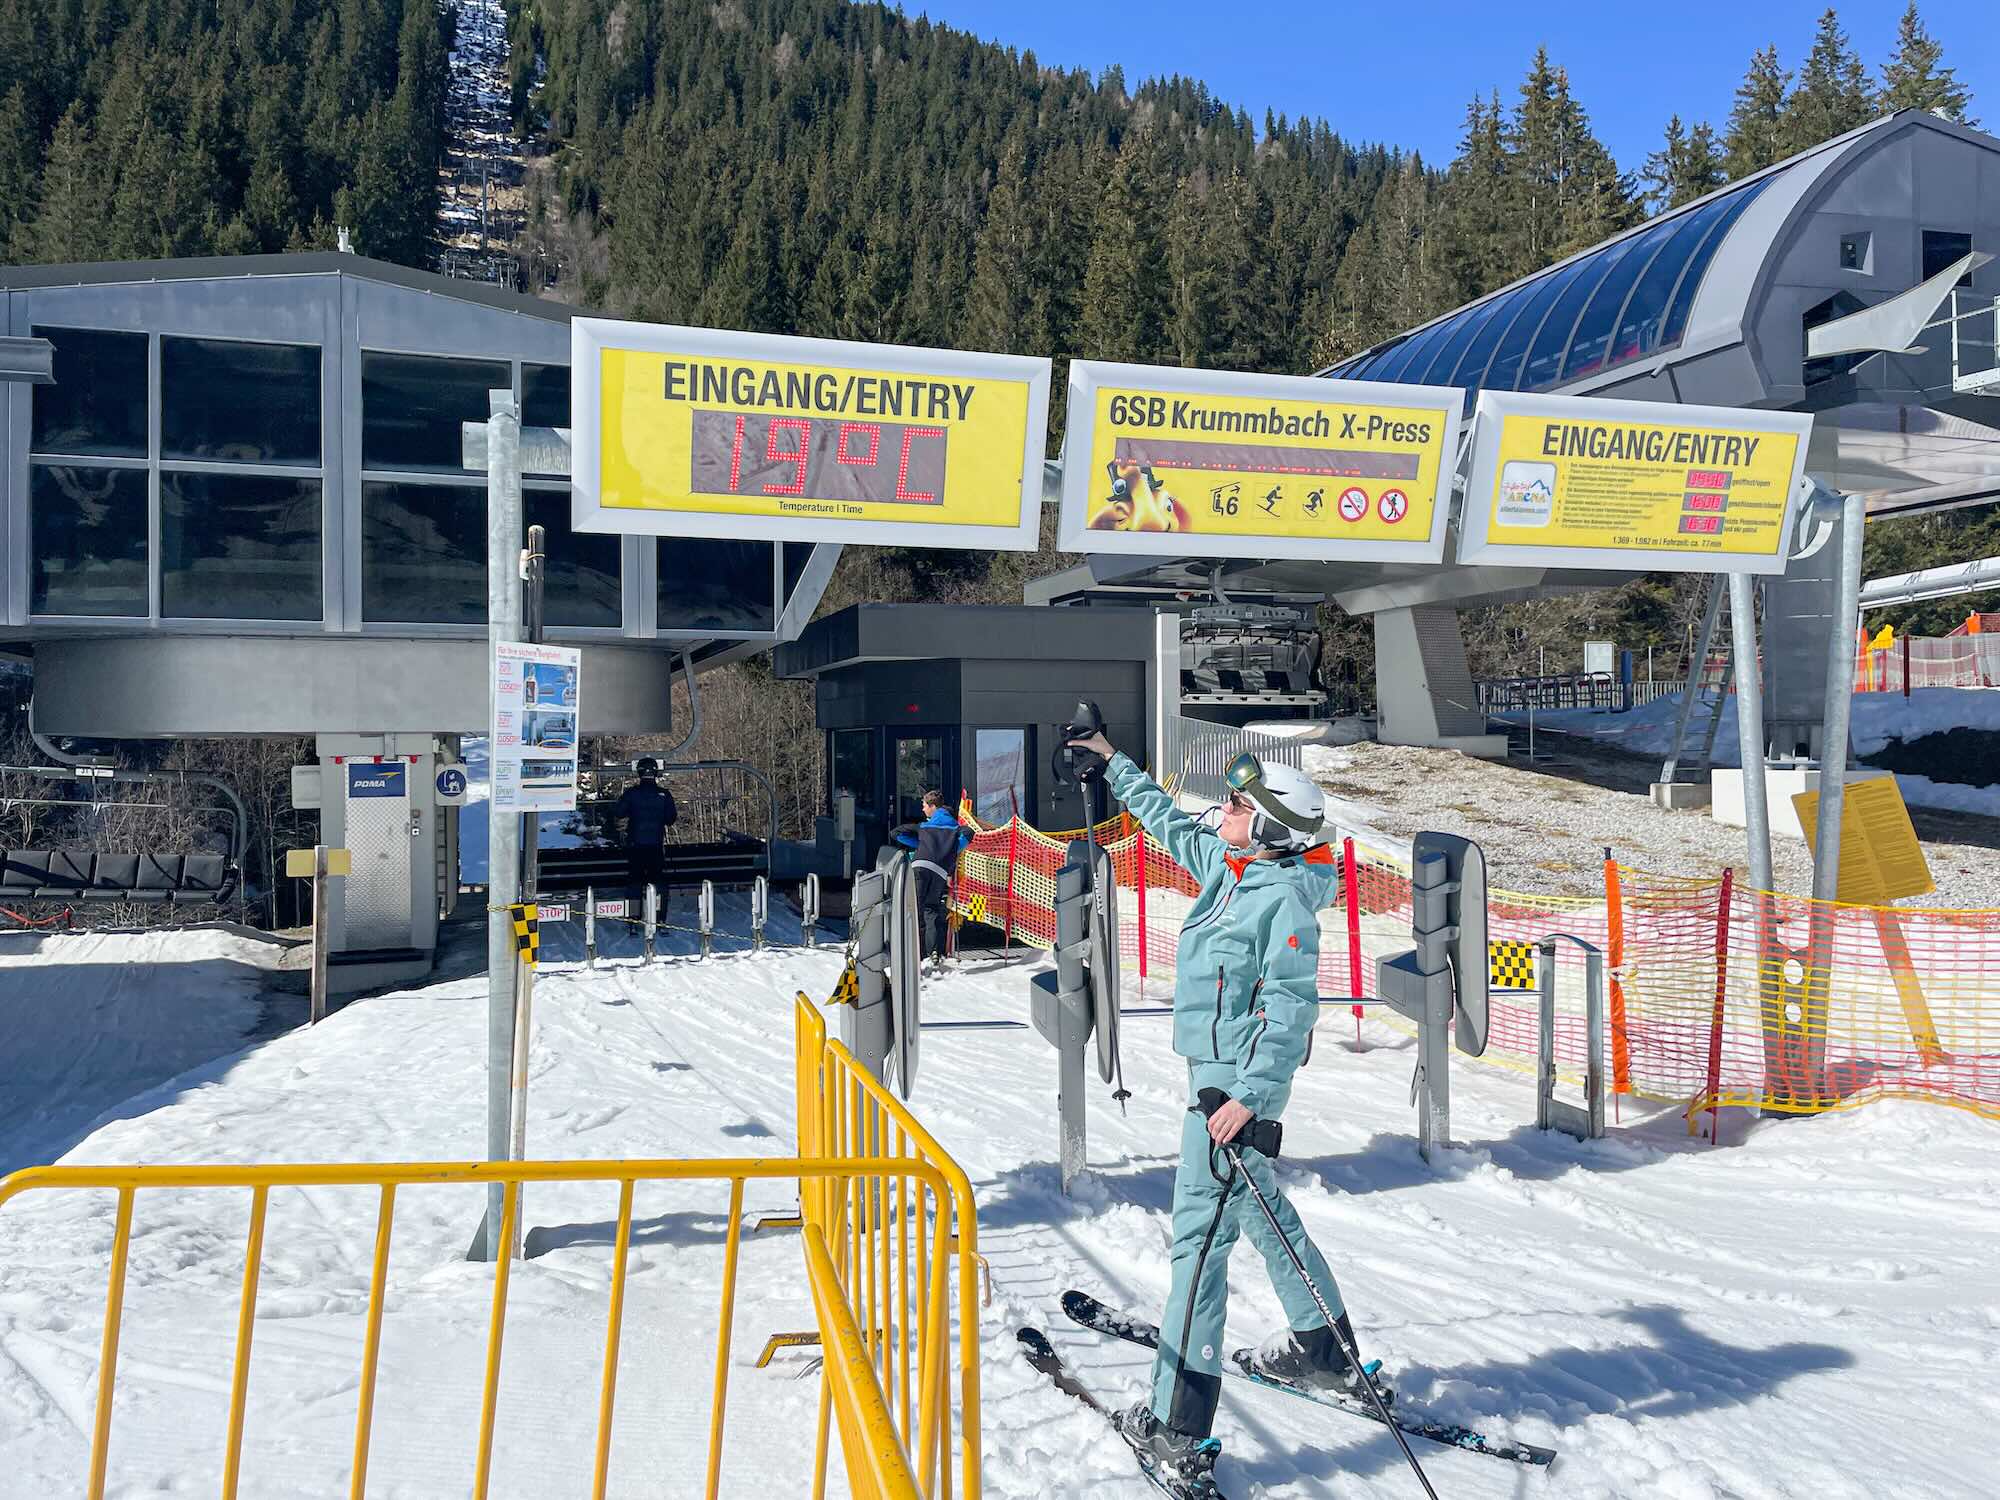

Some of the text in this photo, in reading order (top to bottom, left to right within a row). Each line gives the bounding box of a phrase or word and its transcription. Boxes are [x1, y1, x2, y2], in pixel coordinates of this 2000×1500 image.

[664, 361, 975, 421] EINGANG/ENTRY
[1110, 395, 1431, 444] 6SB Krummbach X-Press
[1543, 424, 1760, 467] EINGANG/ENTRY
[778, 500, 834, 514] Temperature
[842, 504, 863, 515] Time
[354, 780, 386, 788] POMA
[538, 909, 562, 919] STOP
[599, 904, 623, 914] STOP
